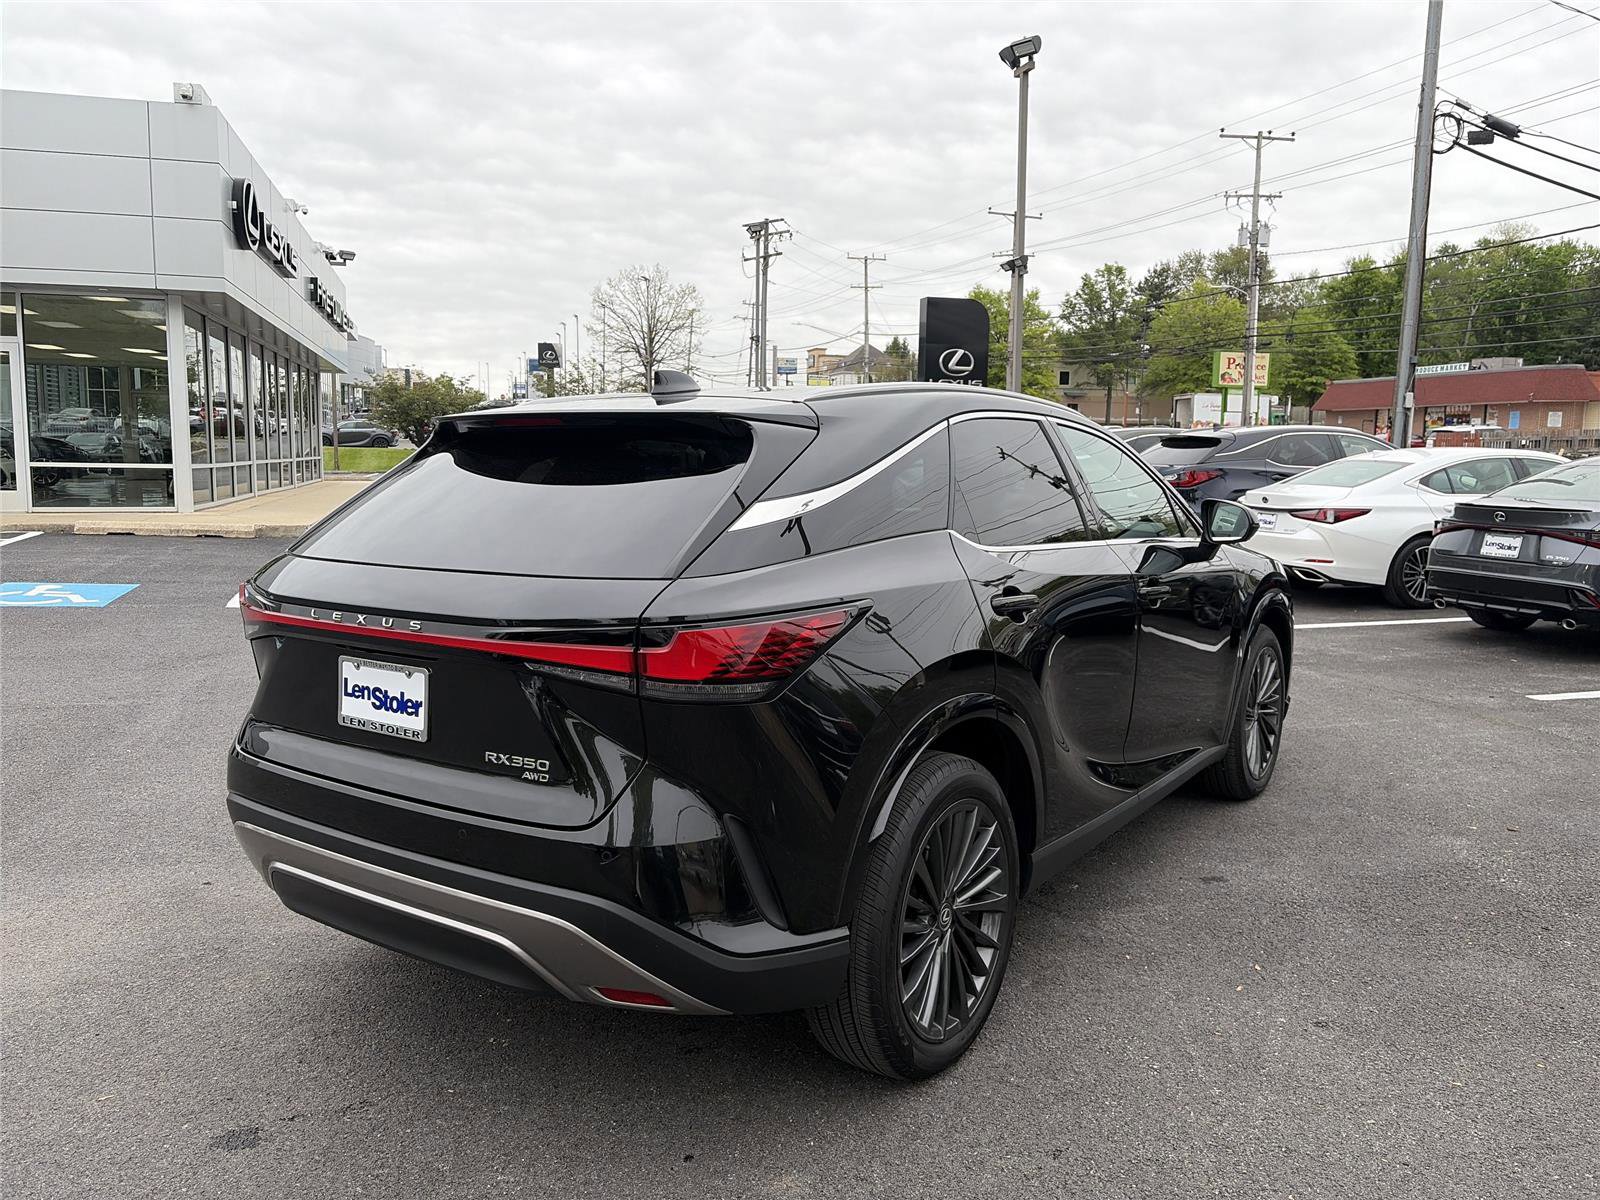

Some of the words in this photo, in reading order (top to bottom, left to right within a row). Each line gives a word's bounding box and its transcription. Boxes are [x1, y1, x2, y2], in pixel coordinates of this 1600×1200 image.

[259, 212, 298, 279] LEXUS
[1226, 357, 1266, 370] Proce
[311, 608, 422, 631] LEXUS
[342, 716, 366, 728] LEN
[370, 721, 421, 740] STOLER
[521, 771, 549, 782] AWD
